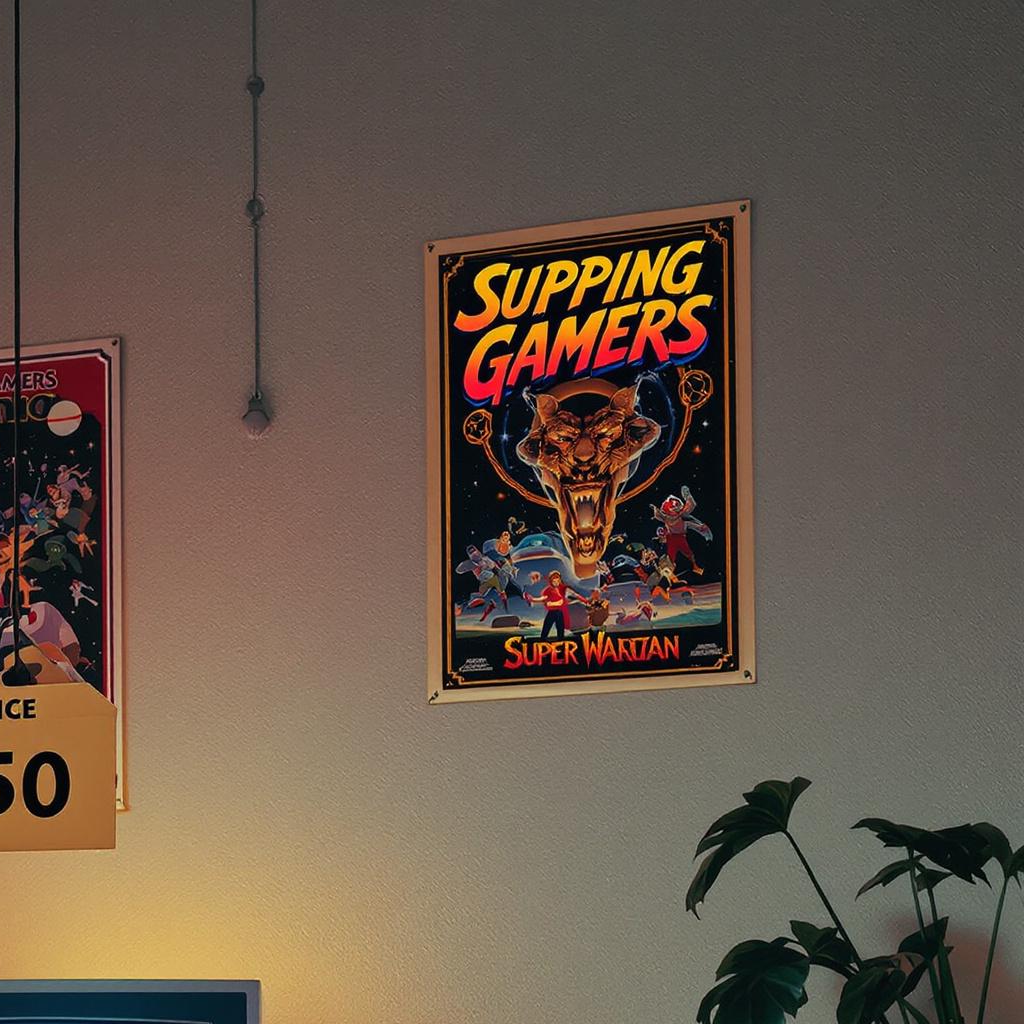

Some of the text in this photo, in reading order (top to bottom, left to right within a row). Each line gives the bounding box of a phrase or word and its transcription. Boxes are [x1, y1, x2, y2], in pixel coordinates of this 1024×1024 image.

[453, 240, 707, 332] SUPPING
[463, 294, 714, 406] GAMERS
[503, 636, 579, 670] SUPER
